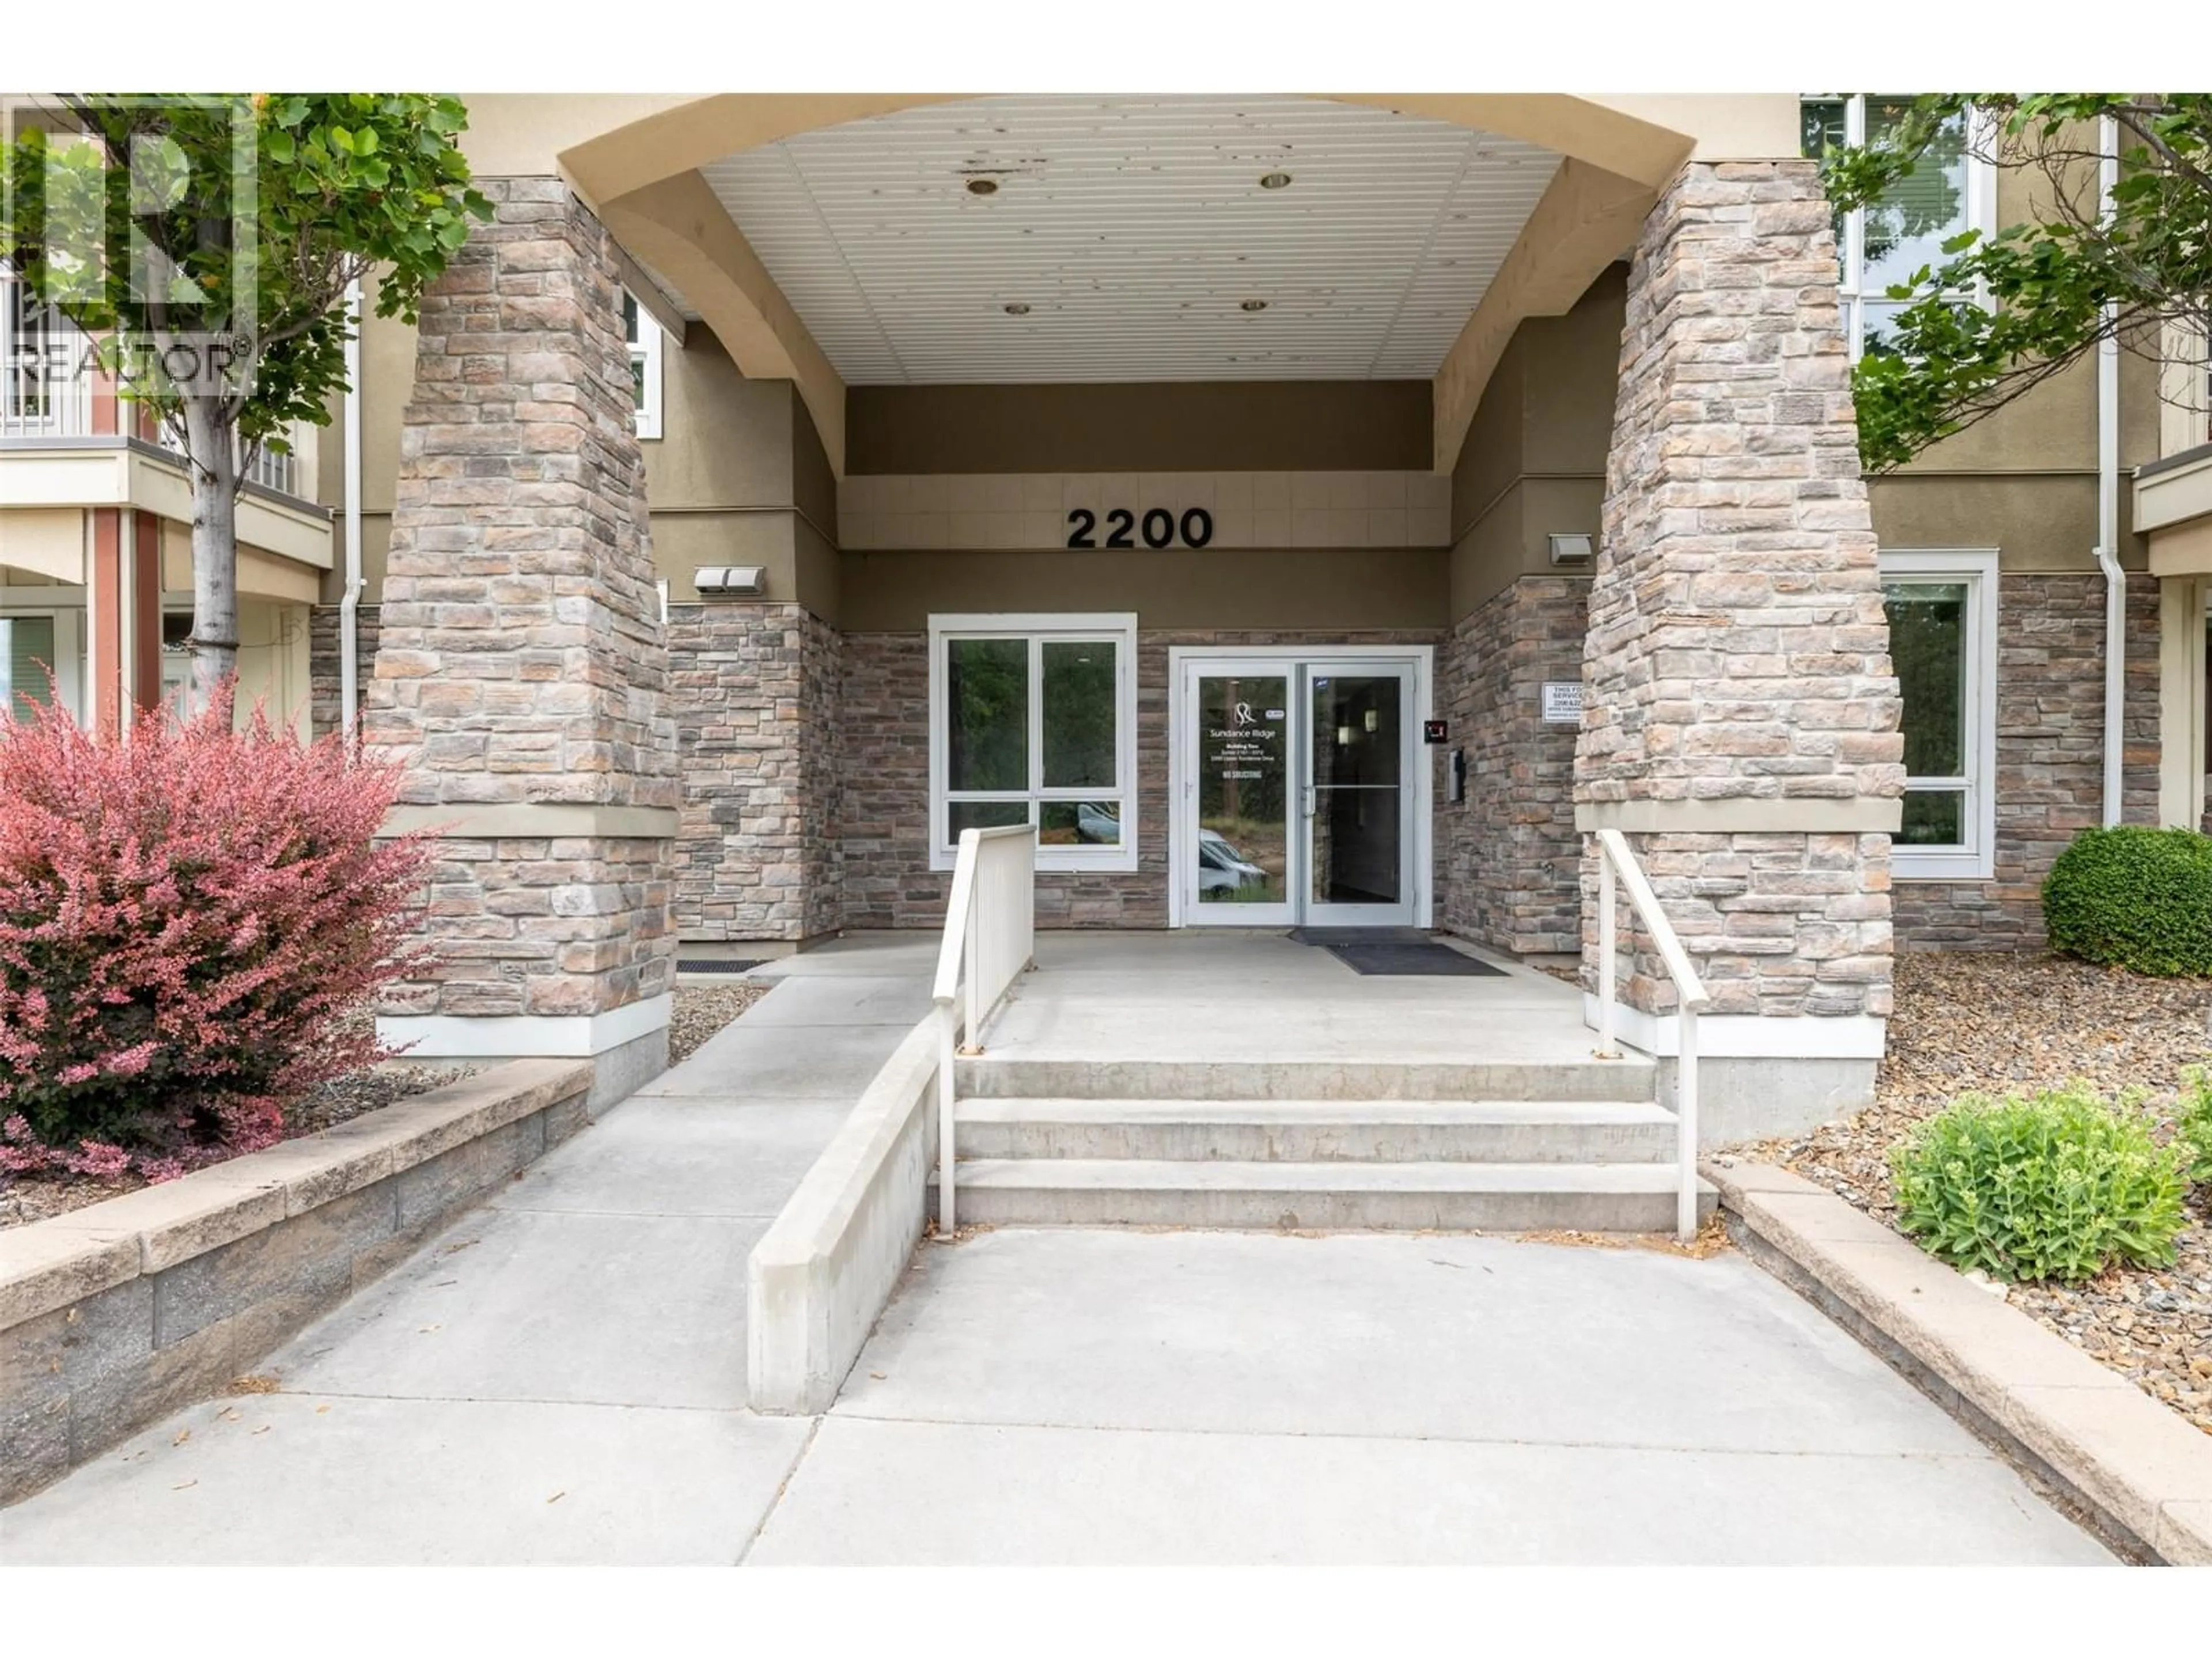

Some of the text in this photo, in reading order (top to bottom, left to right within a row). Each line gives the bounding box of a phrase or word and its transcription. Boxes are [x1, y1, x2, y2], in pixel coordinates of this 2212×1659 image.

[1067, 507, 1213, 549] 2200
[1210, 729, 1276, 739] Sundance Ridge
[1222, 770, 1262, 779] NO SOLICITING
